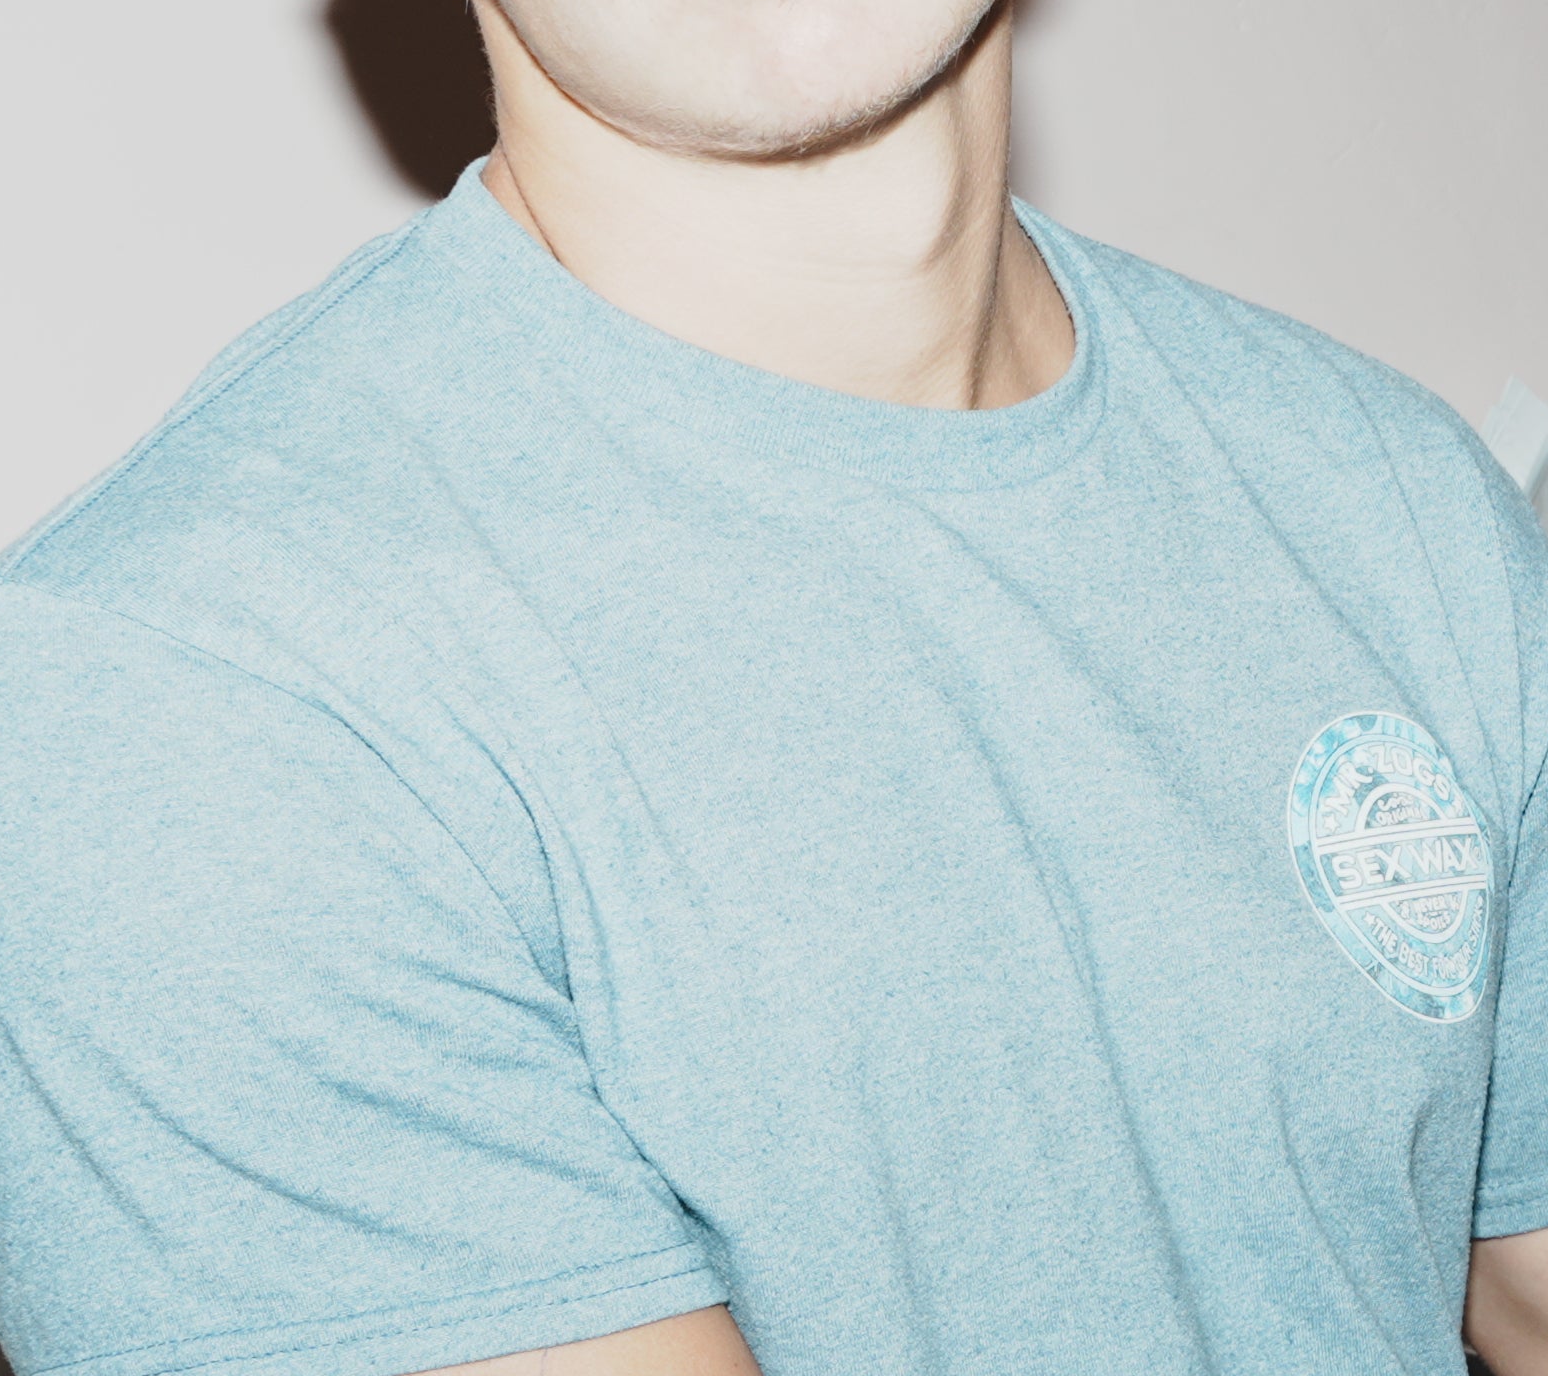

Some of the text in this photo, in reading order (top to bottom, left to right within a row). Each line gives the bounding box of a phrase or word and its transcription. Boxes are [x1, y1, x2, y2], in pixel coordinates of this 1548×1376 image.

[1331, 836, 1478, 891] SEX WAX
[1398, 942, 1430, 977] BEST
